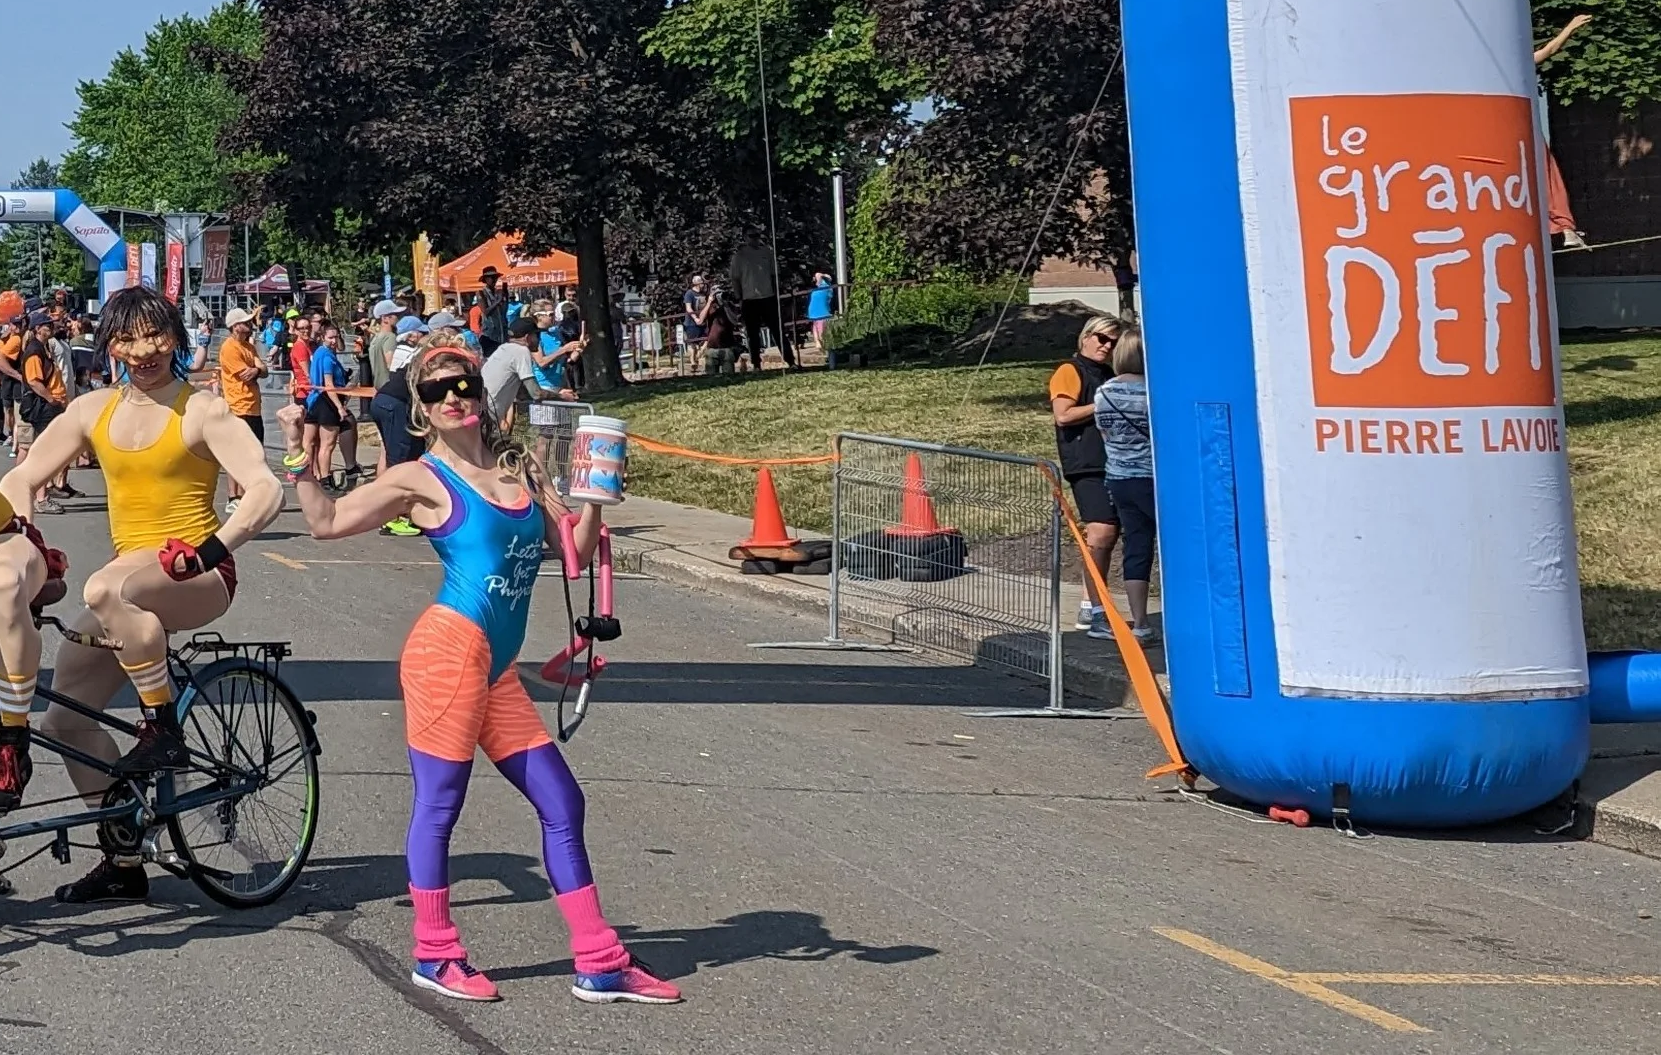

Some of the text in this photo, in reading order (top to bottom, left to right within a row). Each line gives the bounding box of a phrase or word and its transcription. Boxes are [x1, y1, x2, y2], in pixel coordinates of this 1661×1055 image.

[1322, 115, 1367, 156] le
[1318, 140, 1533, 239] grand
[74, 225, 110, 238] Saputo
[168, 254, 180, 297] Saputo
[1315, 418, 1560, 454] PIERRE LAVOIE
[504, 534, 541, 560] Let's
[514, 561, 537, 587] Get
